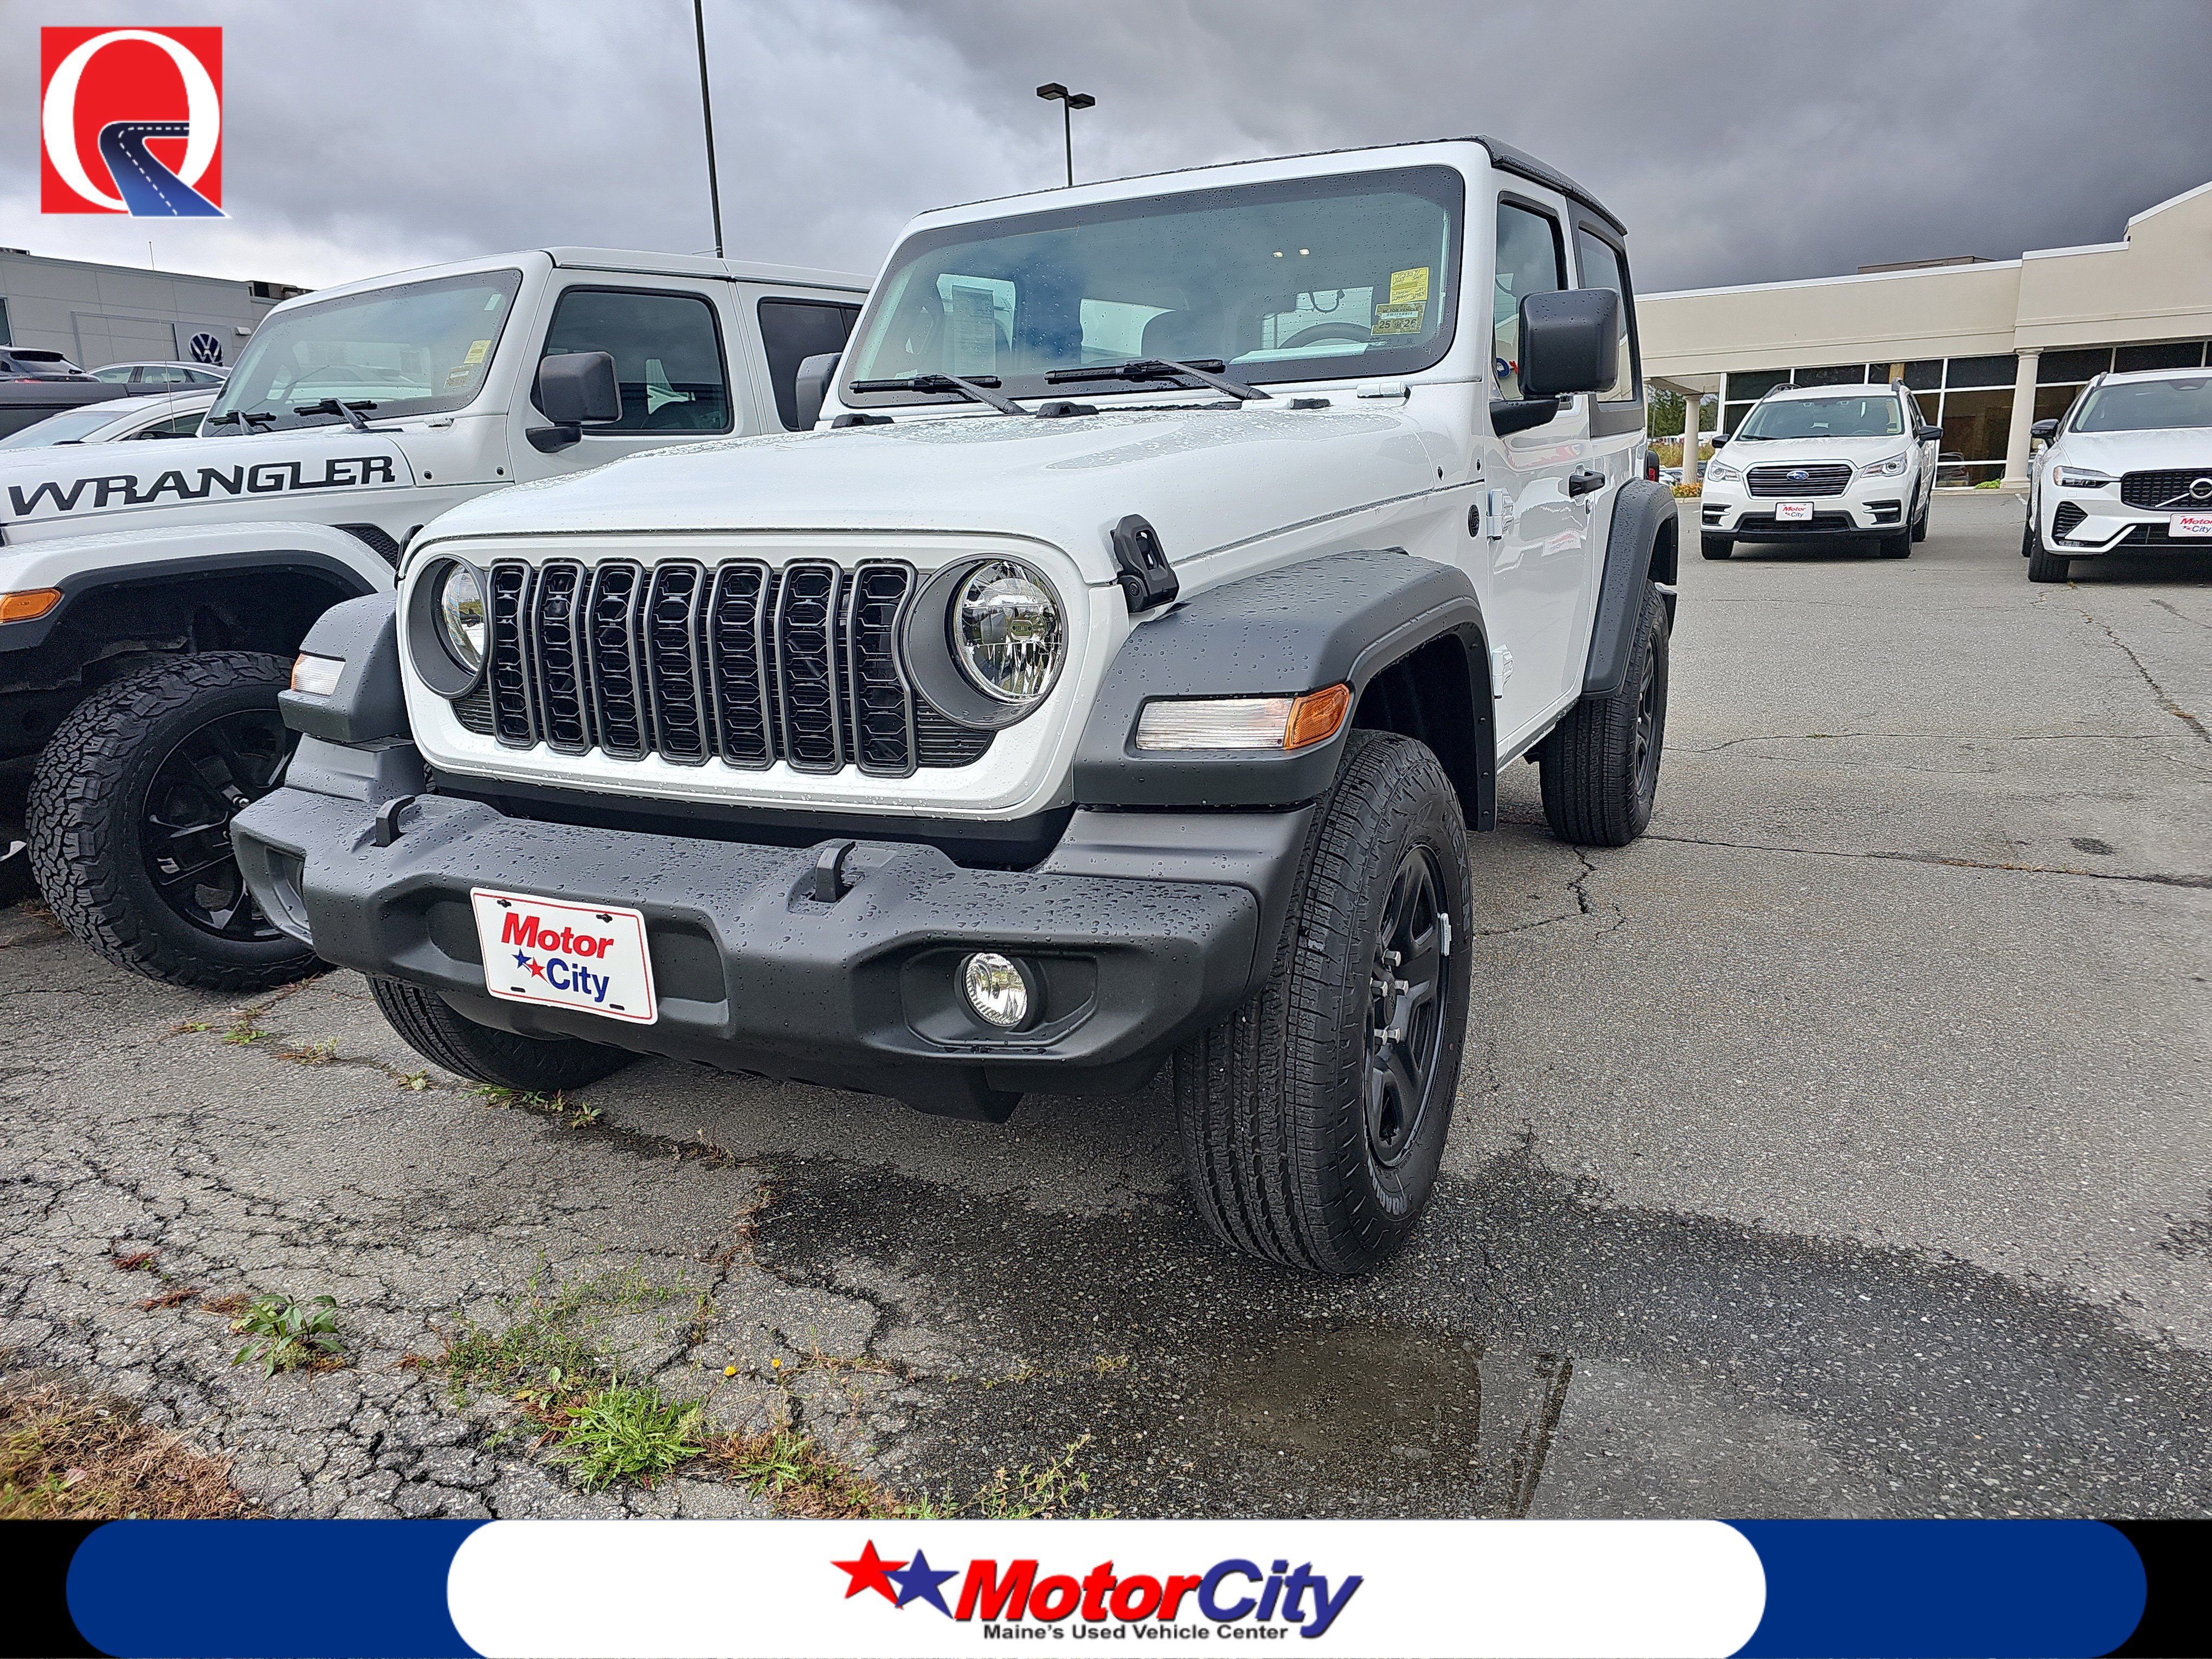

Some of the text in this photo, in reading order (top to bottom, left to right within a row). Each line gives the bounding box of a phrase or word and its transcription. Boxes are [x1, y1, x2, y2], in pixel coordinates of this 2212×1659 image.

[1379, 320, 1391, 329] 25
[8, 456, 396, 516] WRANGLER
[2192, 525, 2212, 533] City
[501, 912, 614, 959] Motor
[546, 957, 610, 1002] City
